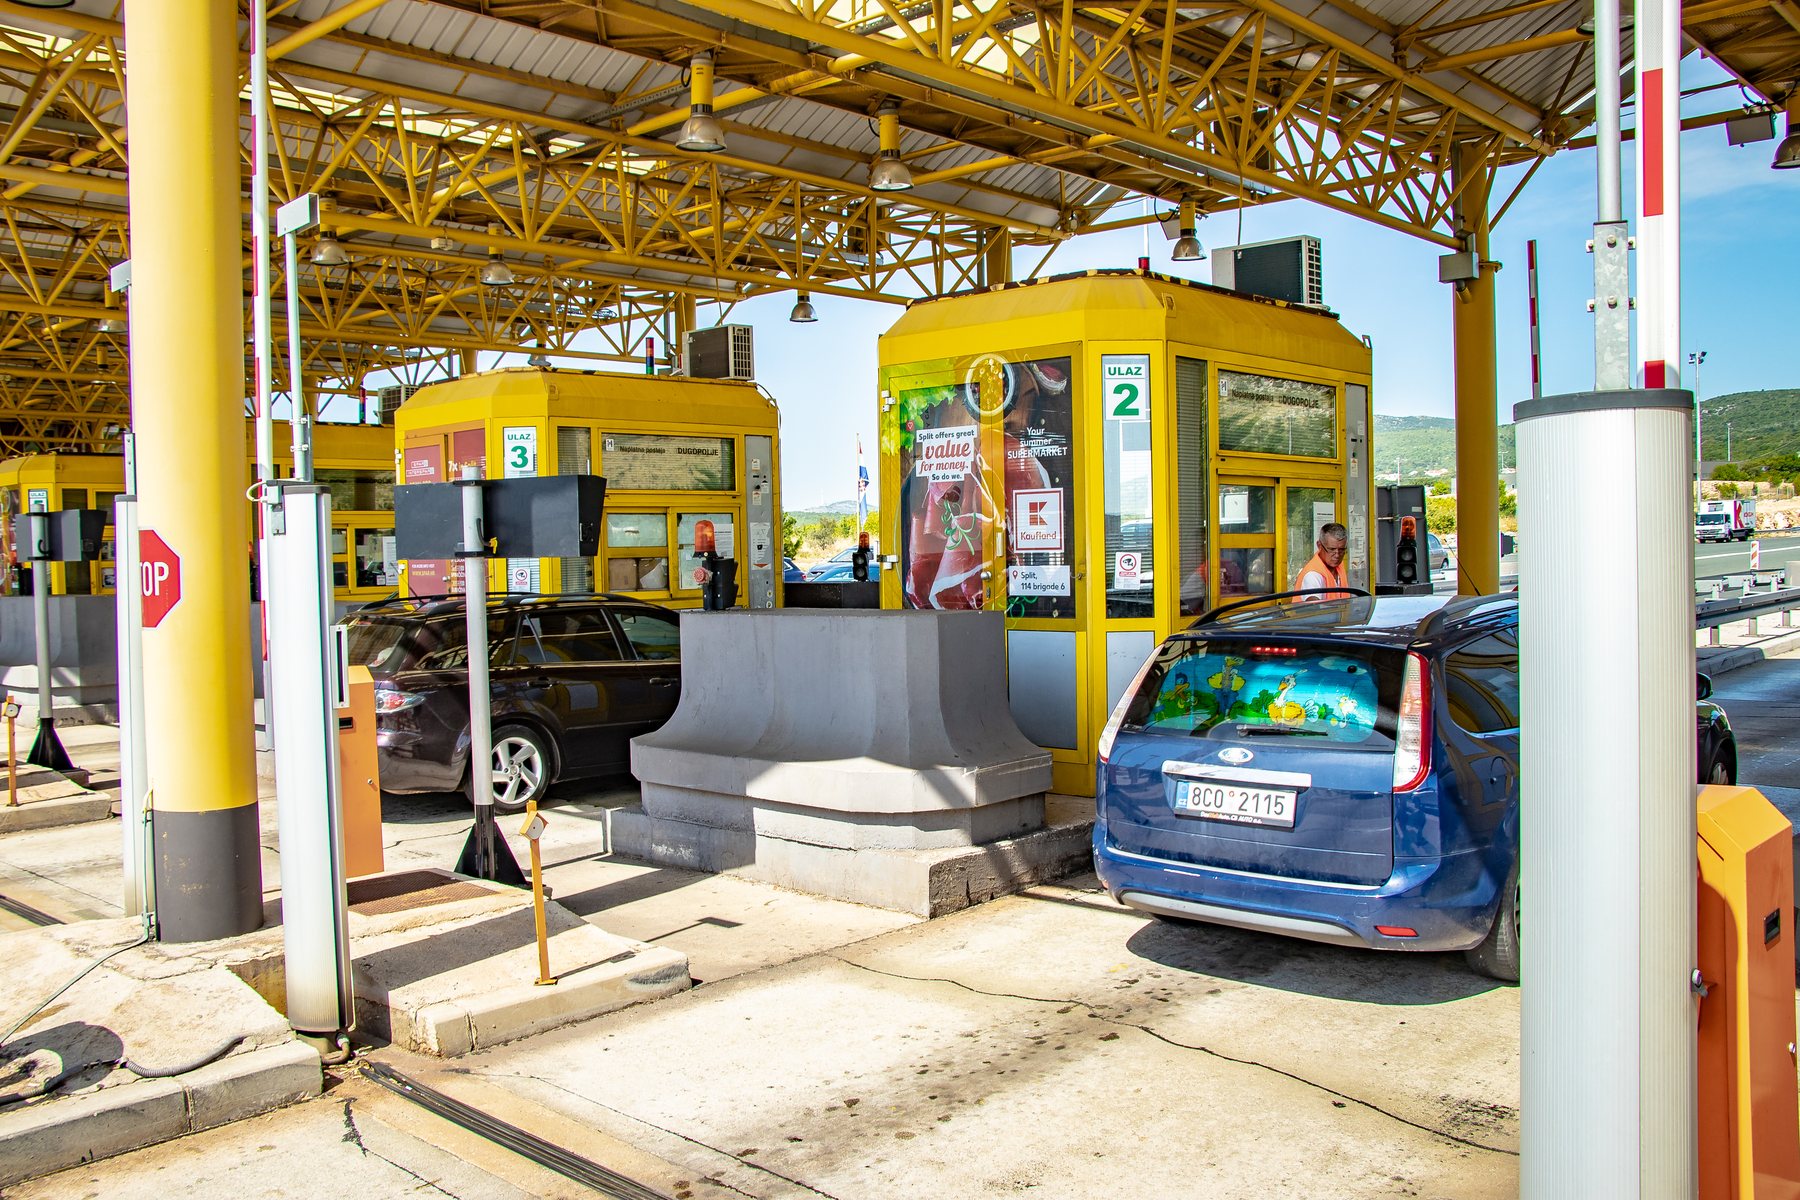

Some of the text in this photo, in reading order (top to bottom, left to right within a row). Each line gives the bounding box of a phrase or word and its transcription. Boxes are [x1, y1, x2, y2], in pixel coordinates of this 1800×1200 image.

[1108, 366, 1142, 376] ULAZ
[1112, 383, 1139, 416] 2
[918, 429, 974, 441] Split offers great
[1026, 427, 1045, 436] Your
[1020, 438, 1052, 447] summer
[677, 447, 719, 456] DUGOPOLJE
[925, 440, 971, 459] value
[1007, 447, 1068, 459] SUPERMARKET
[511, 445, 529, 469] 3
[919, 461, 969, 474] for money.
[1020, 531, 1057, 540] Kaufland
[140, 561, 169, 597] OP
[1021, 571, 1038, 580] Split,
[1021, 582, 1066, 592] 114 brigade 6
[1238, 791, 1286, 815] 2115
